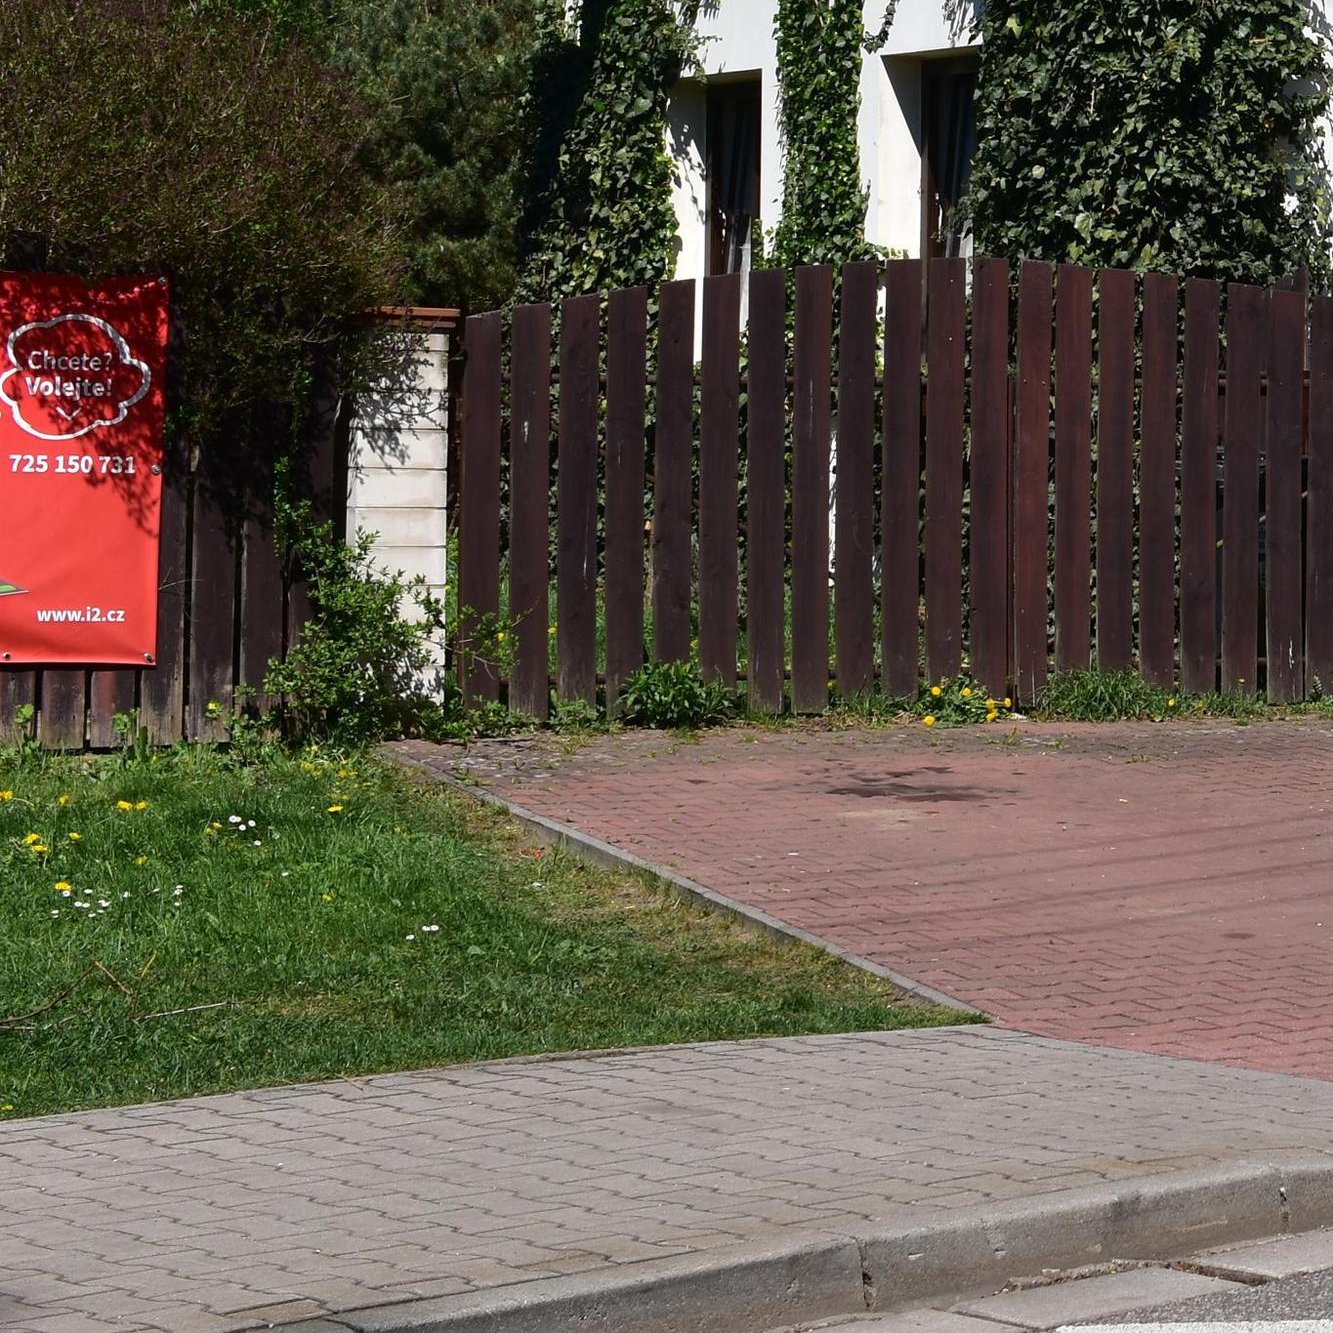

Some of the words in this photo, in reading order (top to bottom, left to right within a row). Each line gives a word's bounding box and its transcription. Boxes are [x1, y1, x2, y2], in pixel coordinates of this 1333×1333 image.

[28, 350, 112, 371] Chcete?
[25, 376, 112, 400] Volejte!
[9, 454, 49, 473] 725
[55, 455, 93, 474] 150
[99, 455, 136, 474] 731
[37, 606, 125, 622] www.i2.cz
